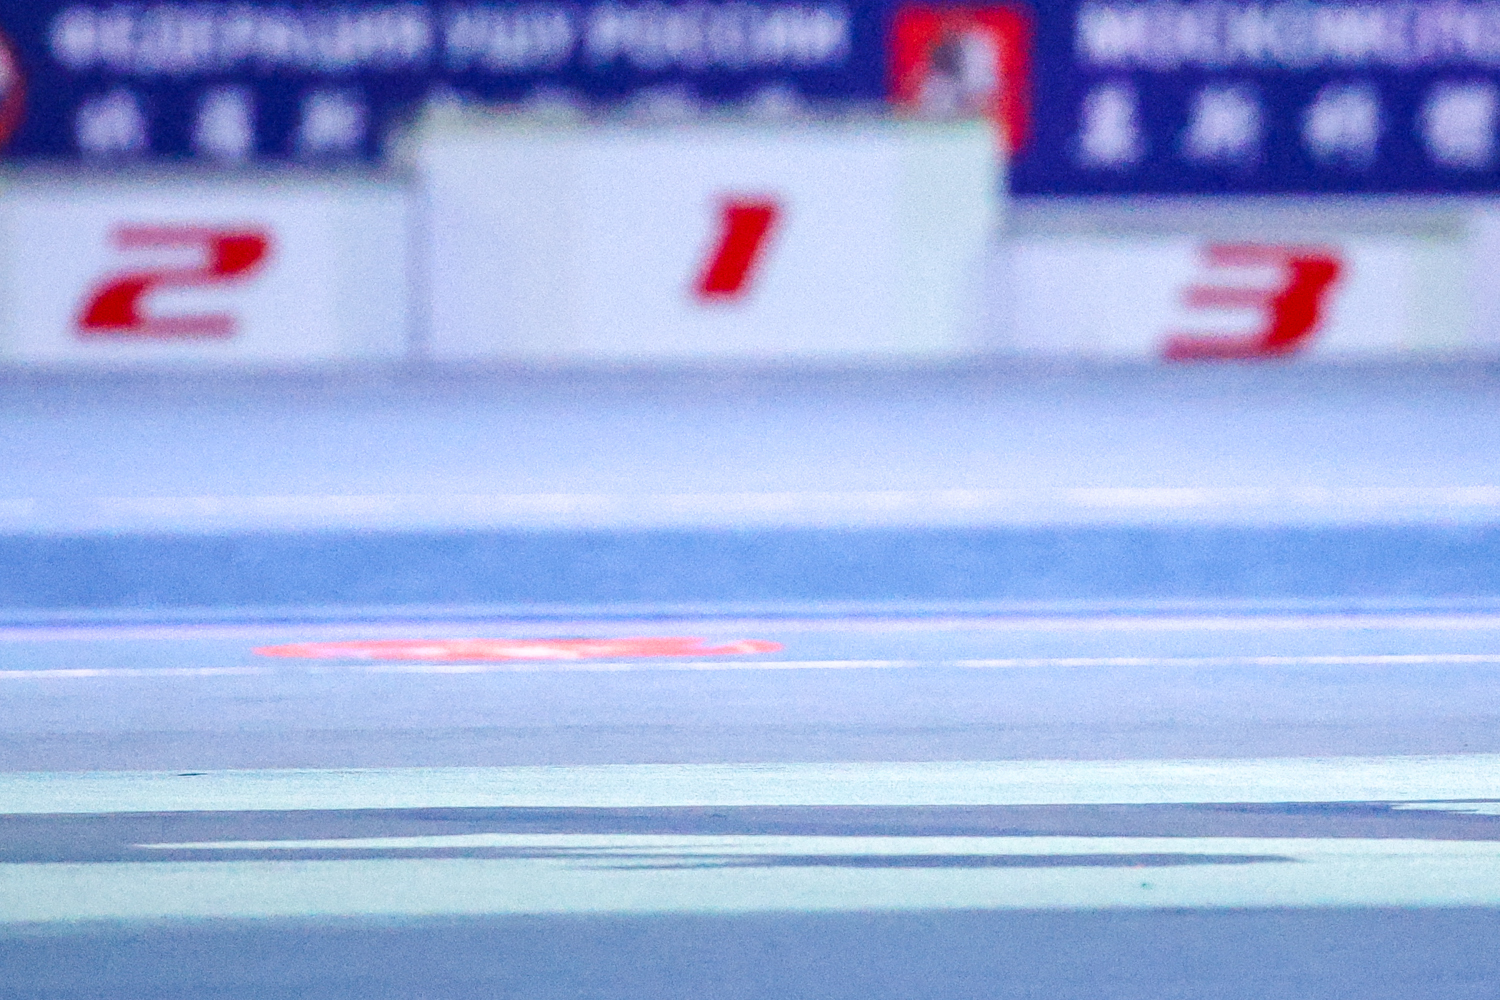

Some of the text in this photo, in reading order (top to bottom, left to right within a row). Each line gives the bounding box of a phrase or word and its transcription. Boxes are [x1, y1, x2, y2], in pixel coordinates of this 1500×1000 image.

[53, 4, 848, 72] ФЕДЕРАЦИЯ УШУ РОССИИ
[74, 224, 271, 336] 2
[695, 194, 782, 299] 1
[1164, 244, 1345, 360] 3
